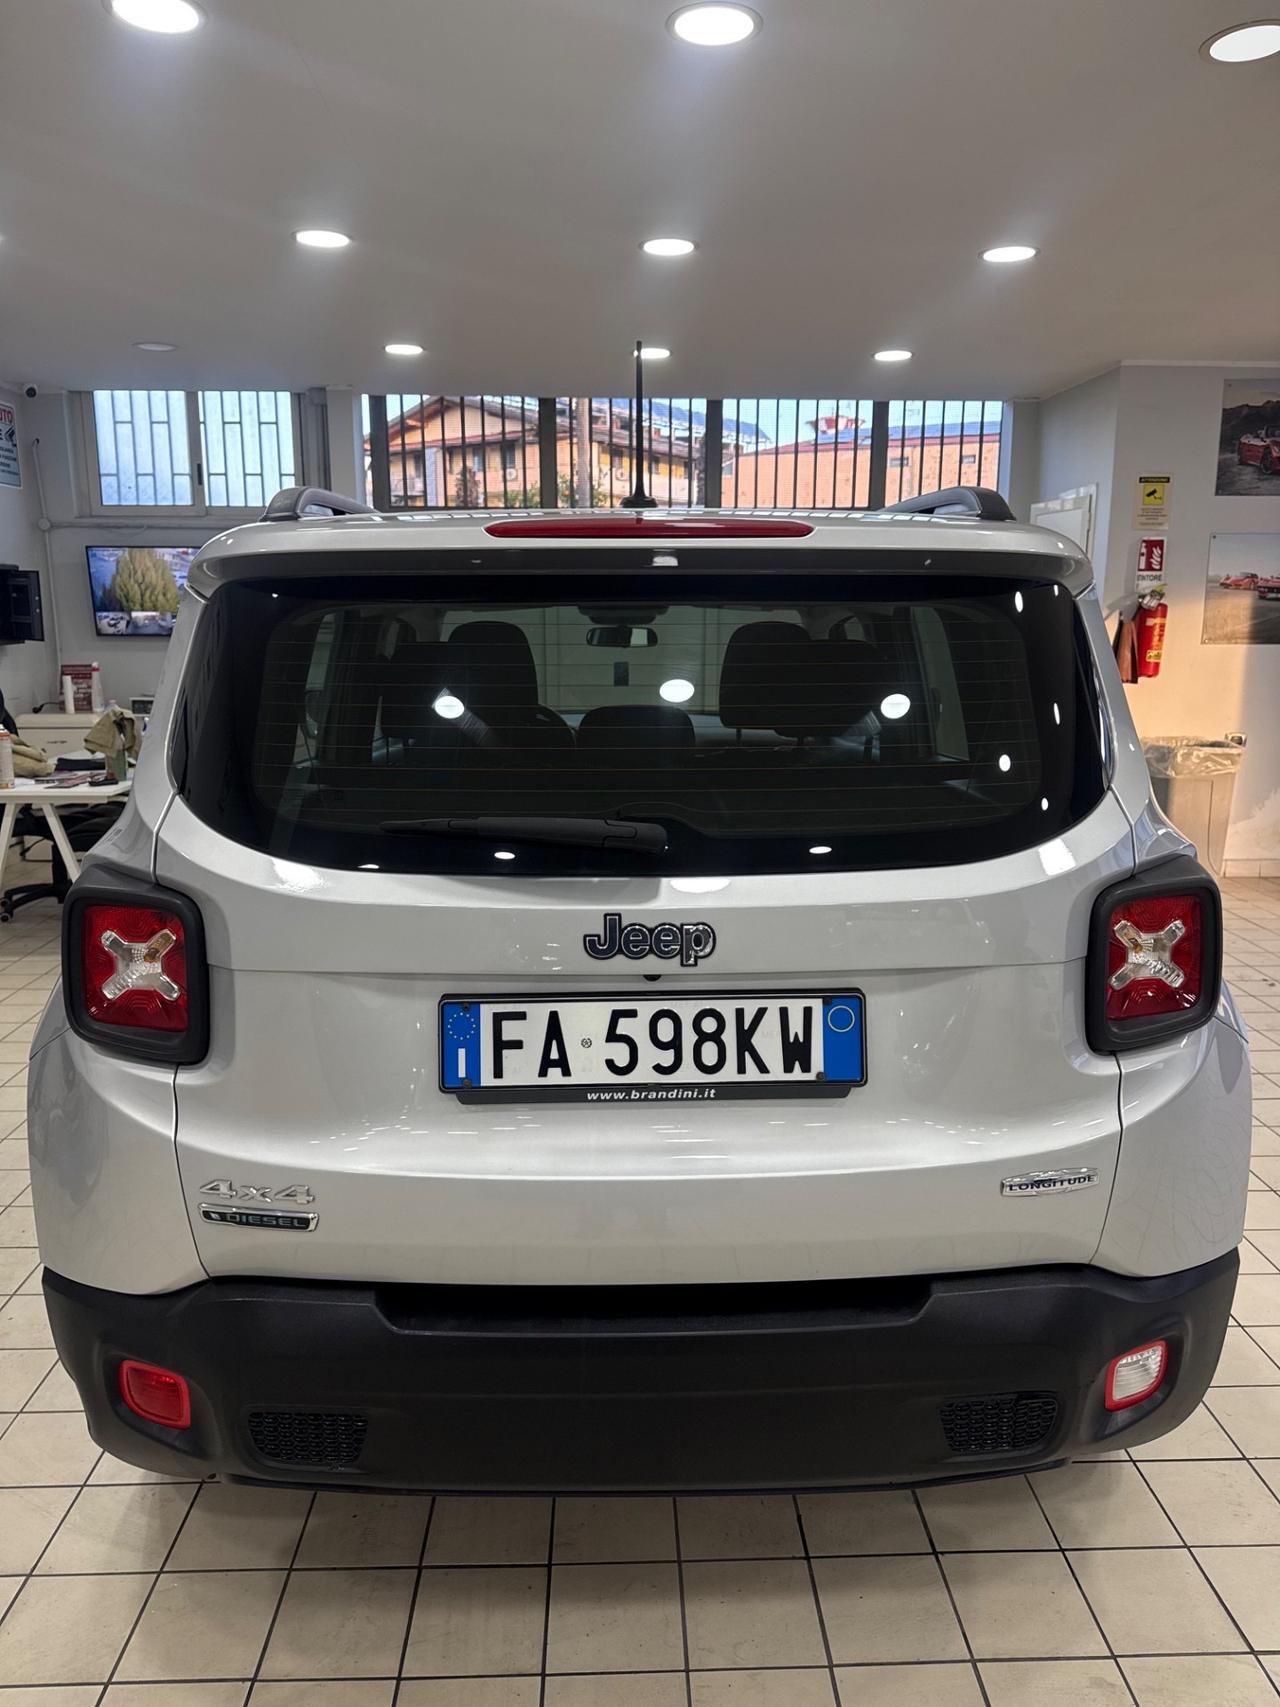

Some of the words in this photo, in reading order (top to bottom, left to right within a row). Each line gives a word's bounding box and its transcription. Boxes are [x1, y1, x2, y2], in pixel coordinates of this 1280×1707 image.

[583, 913, 717, 967] Jeep
[492, 1010, 572, 1079] FA
[604, 1006, 813, 1076] 598KW
[586, 1088, 716, 1101] www.brandini.it
[199, 1178, 315, 1204] 4x4
[1008, 1174, 1096, 1191] LONGITUDE
[226, 1213, 306, 1227] DIESEL
